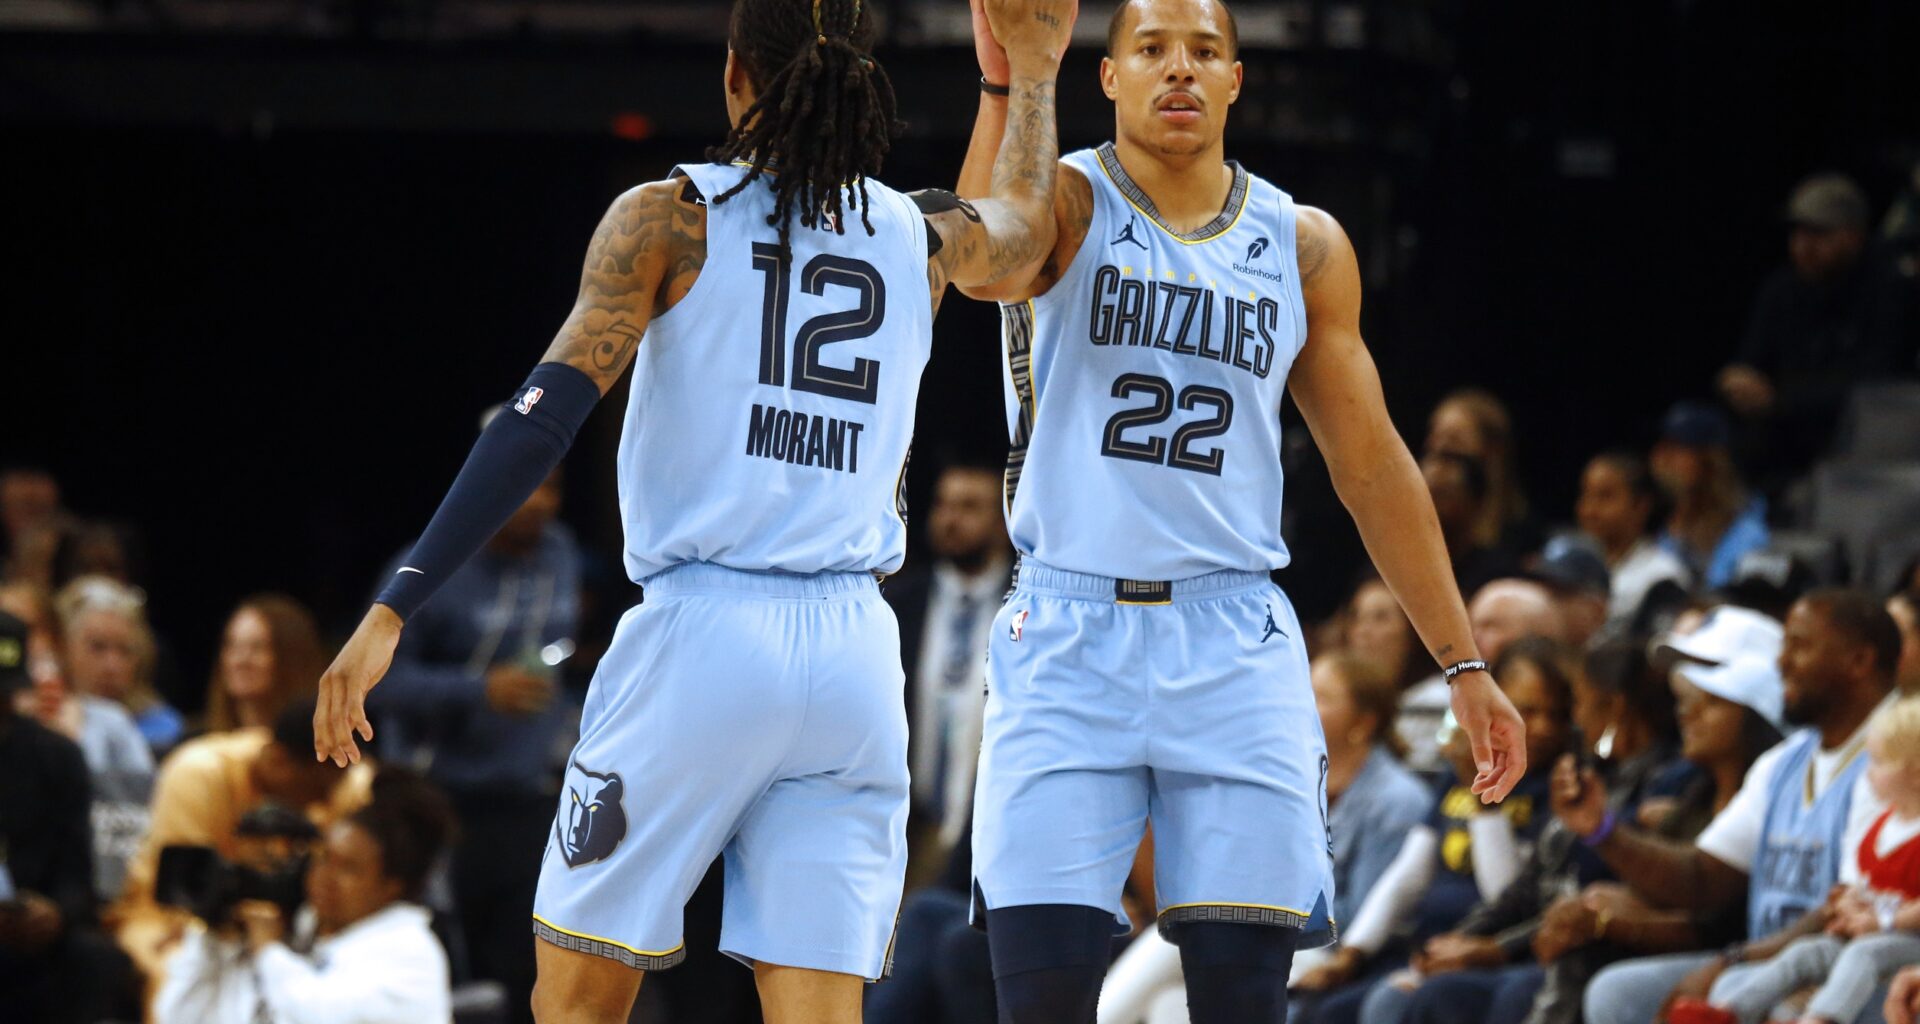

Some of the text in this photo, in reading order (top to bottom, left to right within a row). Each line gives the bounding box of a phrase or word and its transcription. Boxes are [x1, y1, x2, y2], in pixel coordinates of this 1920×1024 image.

[752, 241, 885, 404] 12
[1090, 265, 1278, 379] GRIZZLIES
[1233, 263, 1281, 282] Robinhood
[746, 404, 863, 473] MORANT
[1101, 373, 1233, 476] 22
